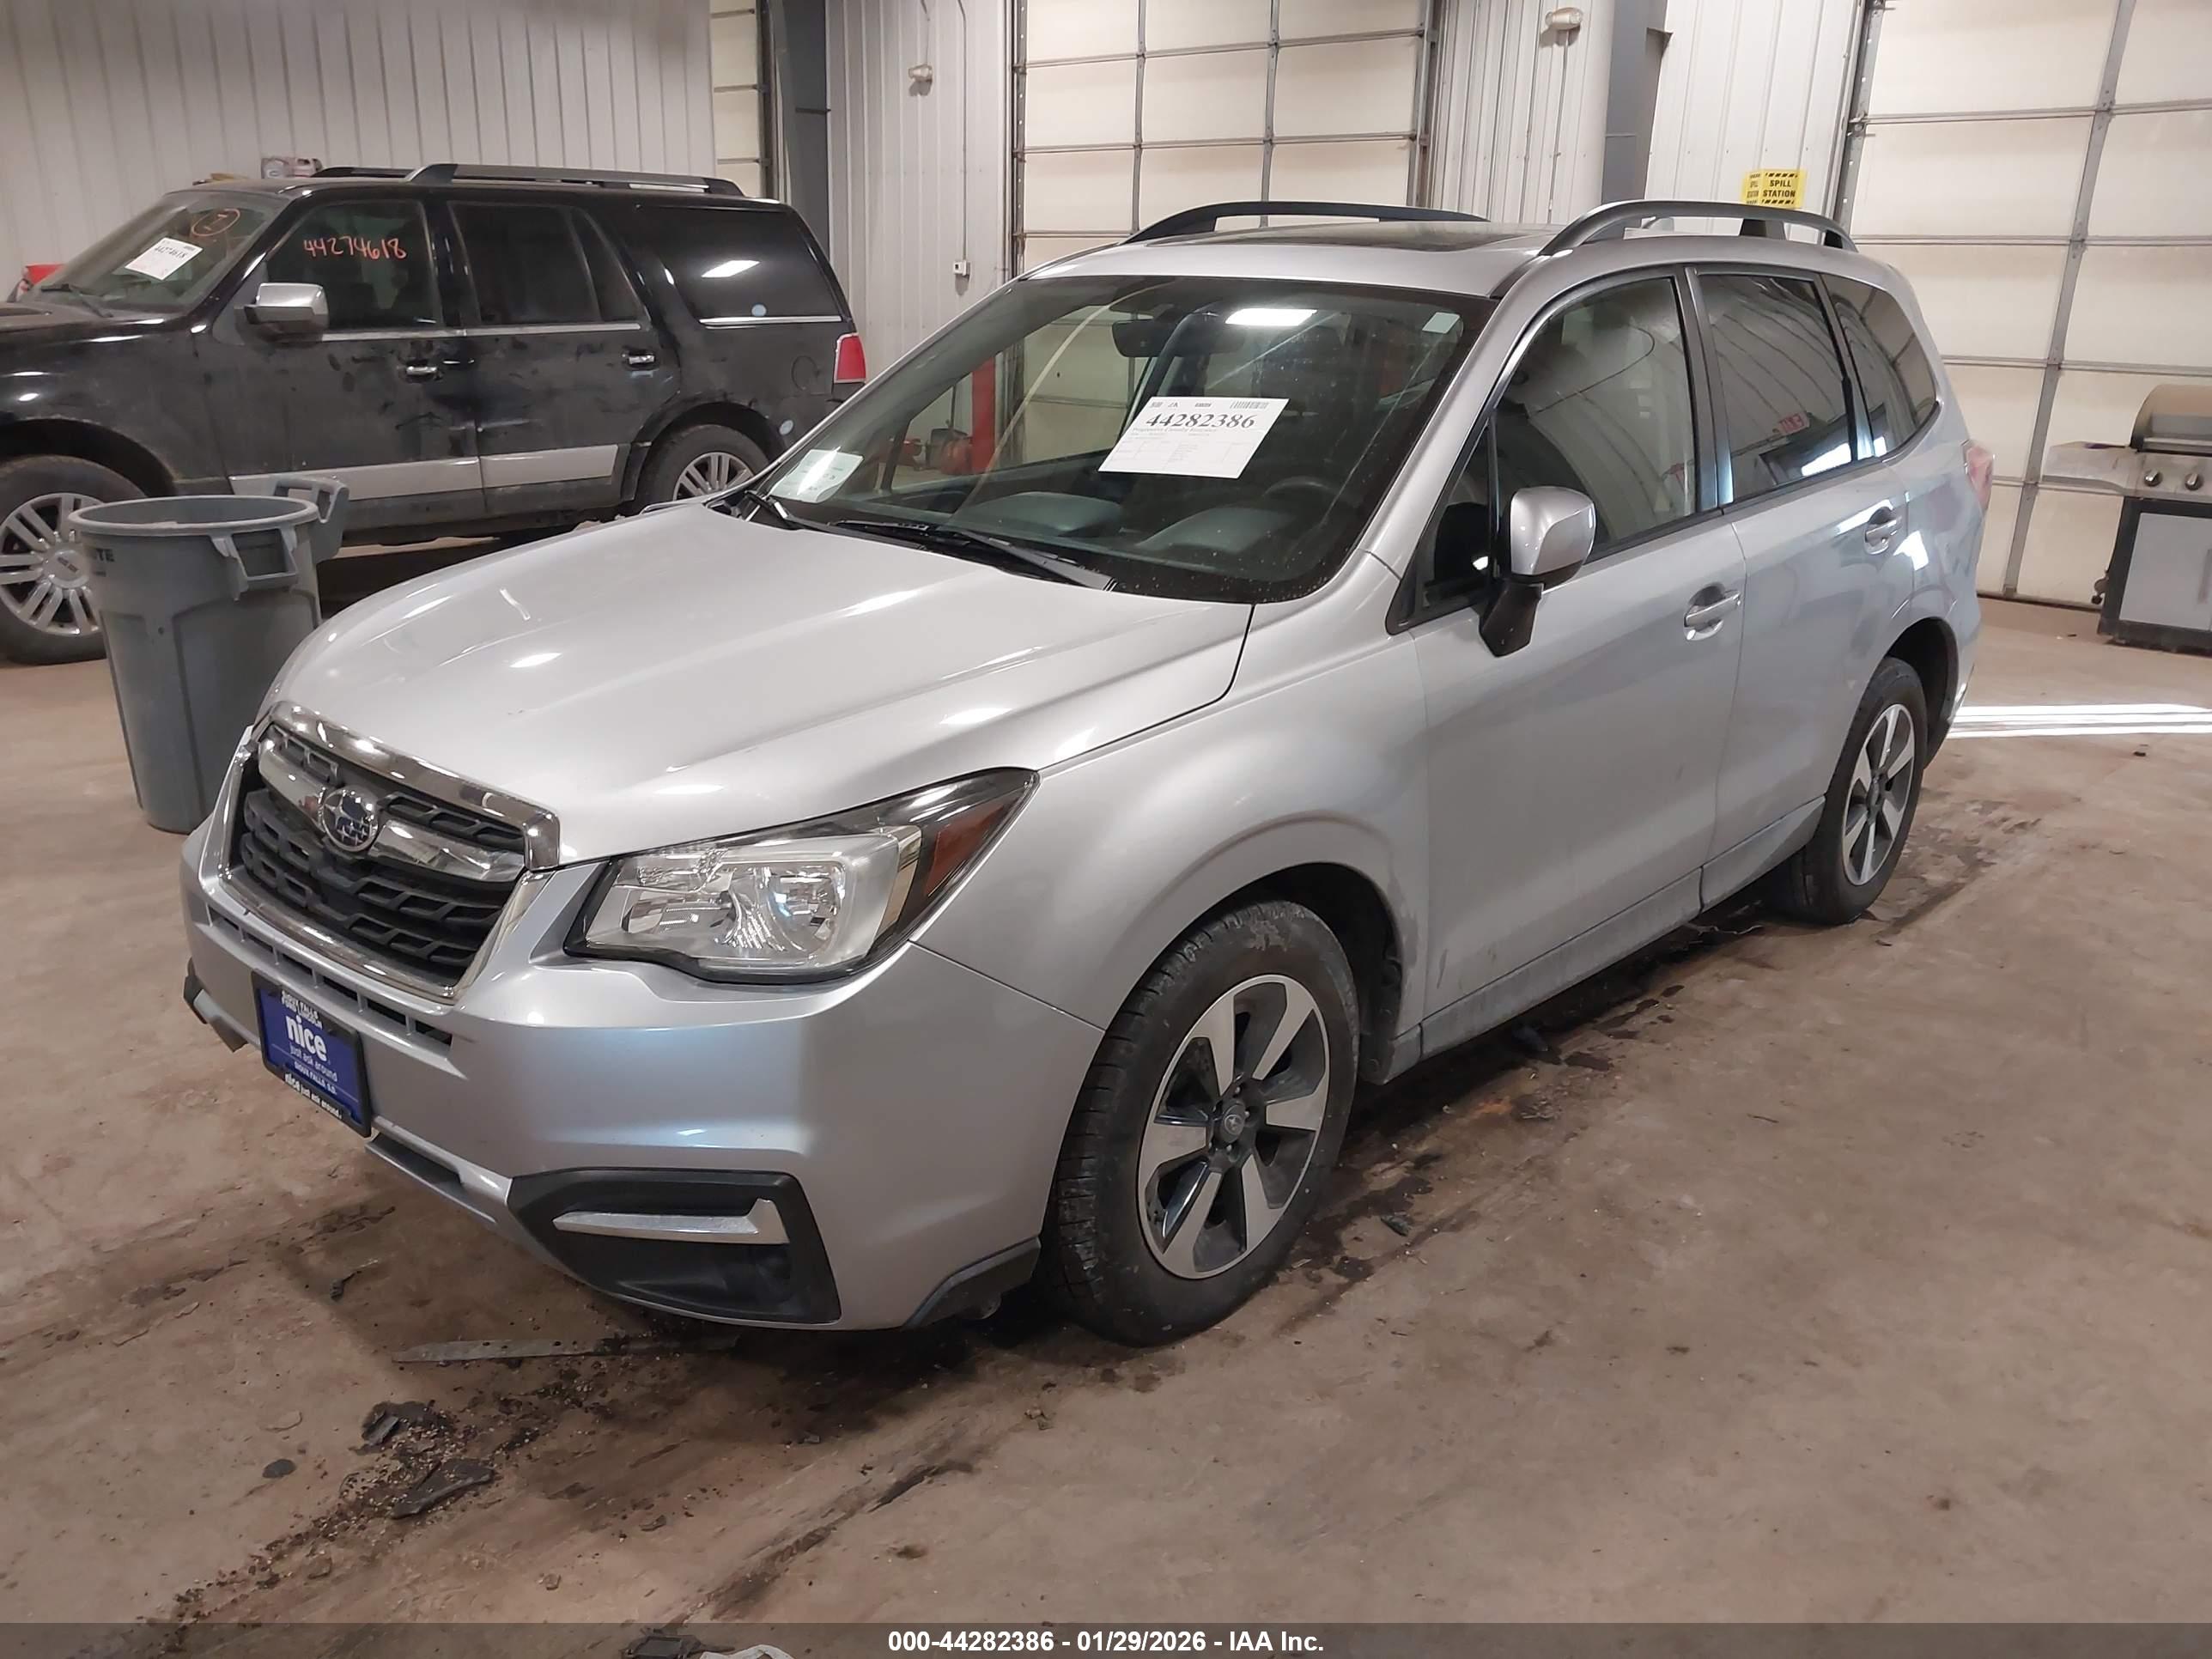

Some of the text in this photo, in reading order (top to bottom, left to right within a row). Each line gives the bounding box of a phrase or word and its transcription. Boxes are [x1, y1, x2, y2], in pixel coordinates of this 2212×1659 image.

[303, 235, 407, 259] 44274618
[1146, 413, 1257, 428] 44282386
[285, 1015, 327, 1061] nice
